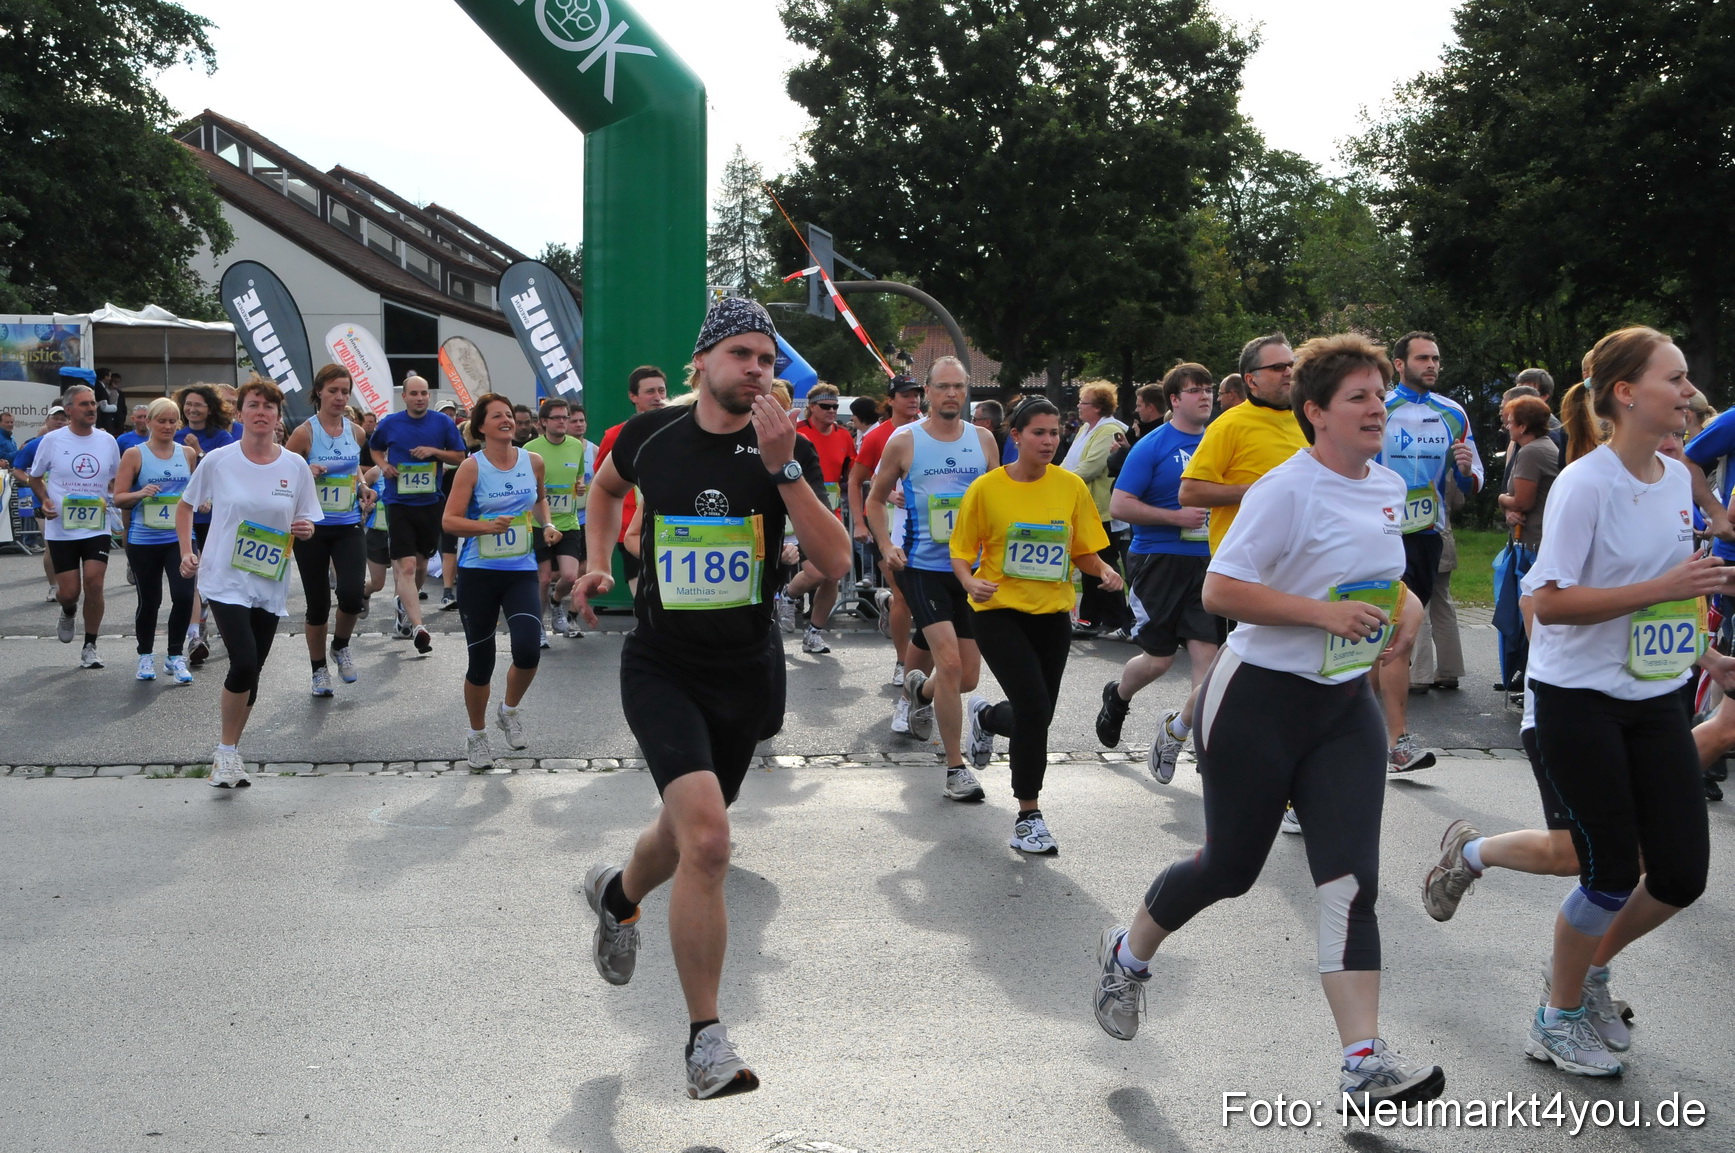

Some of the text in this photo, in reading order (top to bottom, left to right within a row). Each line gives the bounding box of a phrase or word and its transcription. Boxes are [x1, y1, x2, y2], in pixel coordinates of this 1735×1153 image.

[513, 0, 658, 104] OK
[1417, 436, 1445, 444] PLAST
[747, 446, 761, 455] DE
[402, 473, 430, 486] 145
[320, 487, 340, 502] 11
[67, 507, 98, 521] 787
[158, 505, 170, 520] 4
[492, 528, 517, 547] 10
[236, 537, 282, 566] 1205
[1008, 542, 1064, 566] 1292
[658, 550, 750, 584] 1186
[676, 586, 716, 596] Matthias
[1632, 622, 1695, 657] 1202
